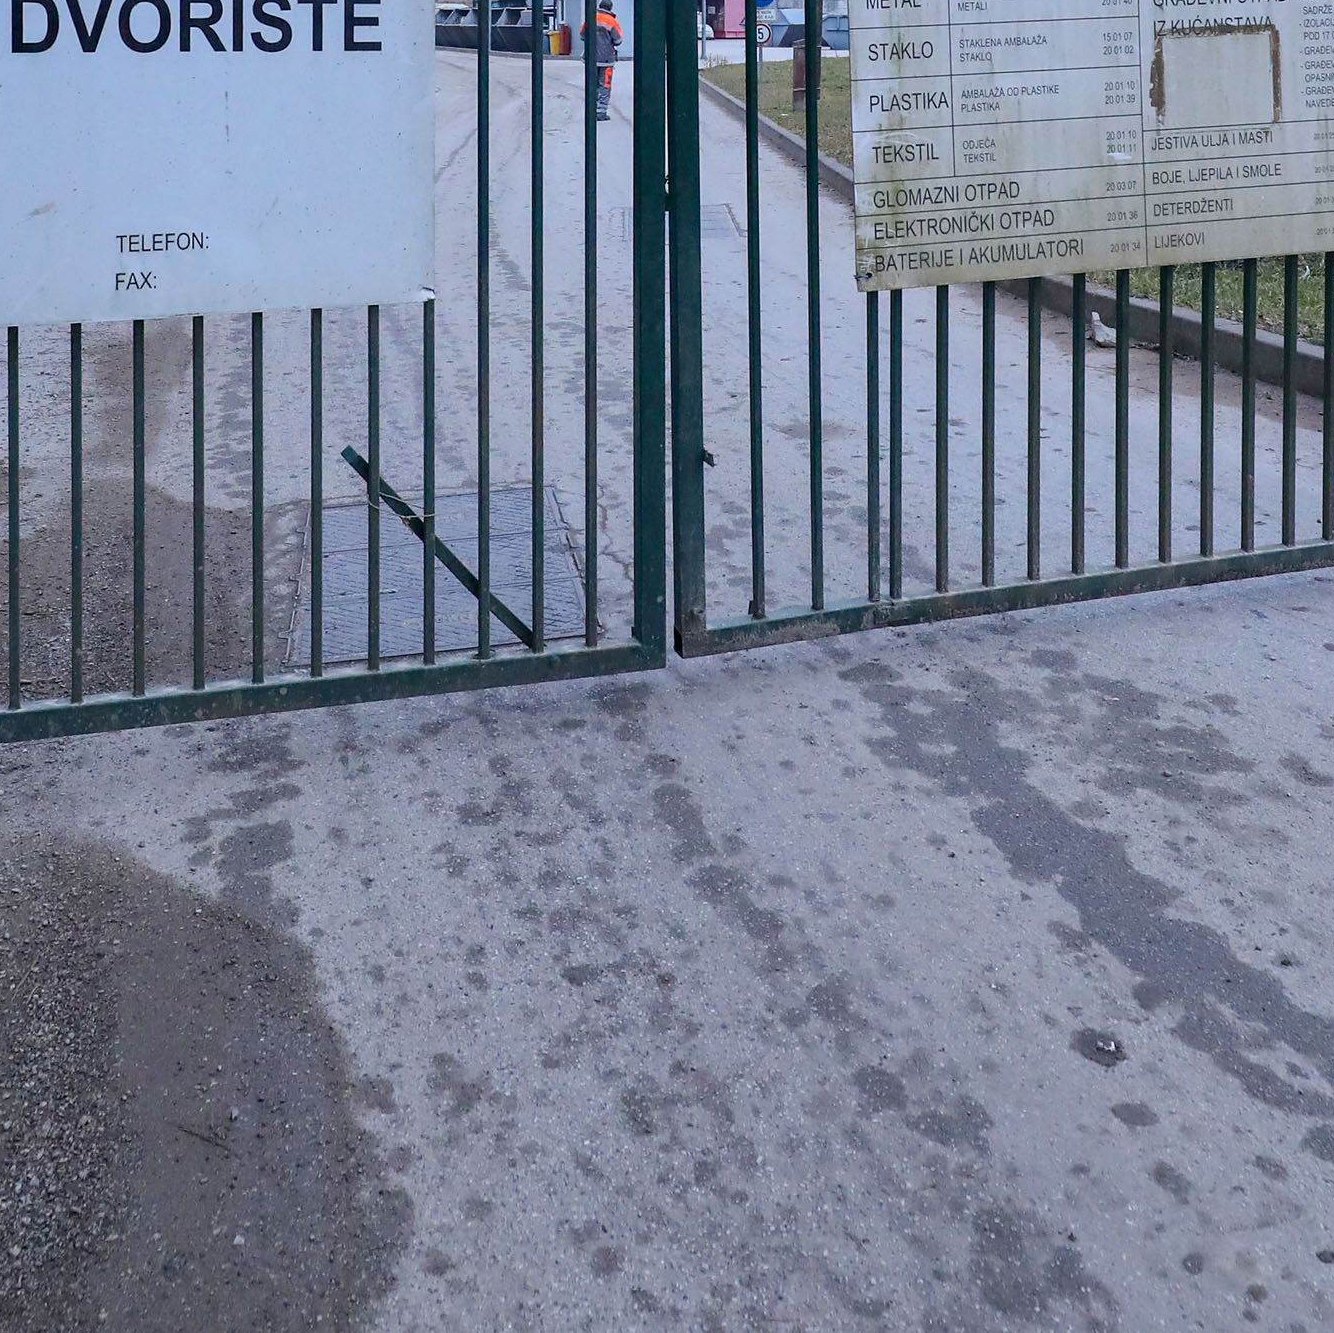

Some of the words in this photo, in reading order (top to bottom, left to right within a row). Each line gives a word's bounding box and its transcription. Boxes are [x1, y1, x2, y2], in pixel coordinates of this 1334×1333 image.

[957, 1, 988, 12] METALI
[758, 28, 763, 39] 5
[1102, 32, 1112, 43] 15
[1112, 31, 1122, 42] 01
[1123, 31, 1133, 42] 07
[1153, 20, 1166, 37] IZ
[958, 37, 1003, 50] STAKLENA
[1003, 34, 1048, 47] AMBALAŽA
[1102, 45, 1113, 56] 20
[1113, 44, 1123, 56] 01
[1124, 44, 1135, 55] 02
[869, 41, 933, 61] STAKLO
[960, 52, 992, 62] STAKLO
[960, 86, 1006, 100] AMBALAŽA
[1006, 86, 1020, 97] OD
[1020, 84, 1060, 96] PLASTIKE
[1104, 94, 1115, 106] 20
[1114, 94, 1124, 105] 01
[1126, 93, 1136, 104] 39
[870, 92, 948, 112] PLASTIKA
[960, 101, 1001, 113] PLASTIKA
[1152, 135, 1198, 150] JESTIVA
[1202, 133, 1229, 147] ULJA
[1239, 131, 1272, 144] MASTI
[872, 143, 939, 163] TEKSTIL
[963, 152, 997, 164] TEKSTIL
[1153, 170, 1185, 185] BOJE,
[1189, 167, 1233, 182] LJEPILA
[1243, 164, 1281, 178] SMOLE
[874, 186, 959, 208] GLOMAZNI
[965, 182, 1019, 201] OTPAD
[1154, 198, 1233, 216] DETERDŽENTI
[875, 211, 994, 239] ELEKTRONIČKI
[1000, 209, 1054, 230] OTPAD
[116, 232, 208, 253] TELEFON:
[1155, 232, 1204, 248] LIJEKOVI
[875, 248, 955, 272] BATERIJE
[969, 239, 1083, 264] AKUMULATORI
[116, 272, 156, 290] FAX:
